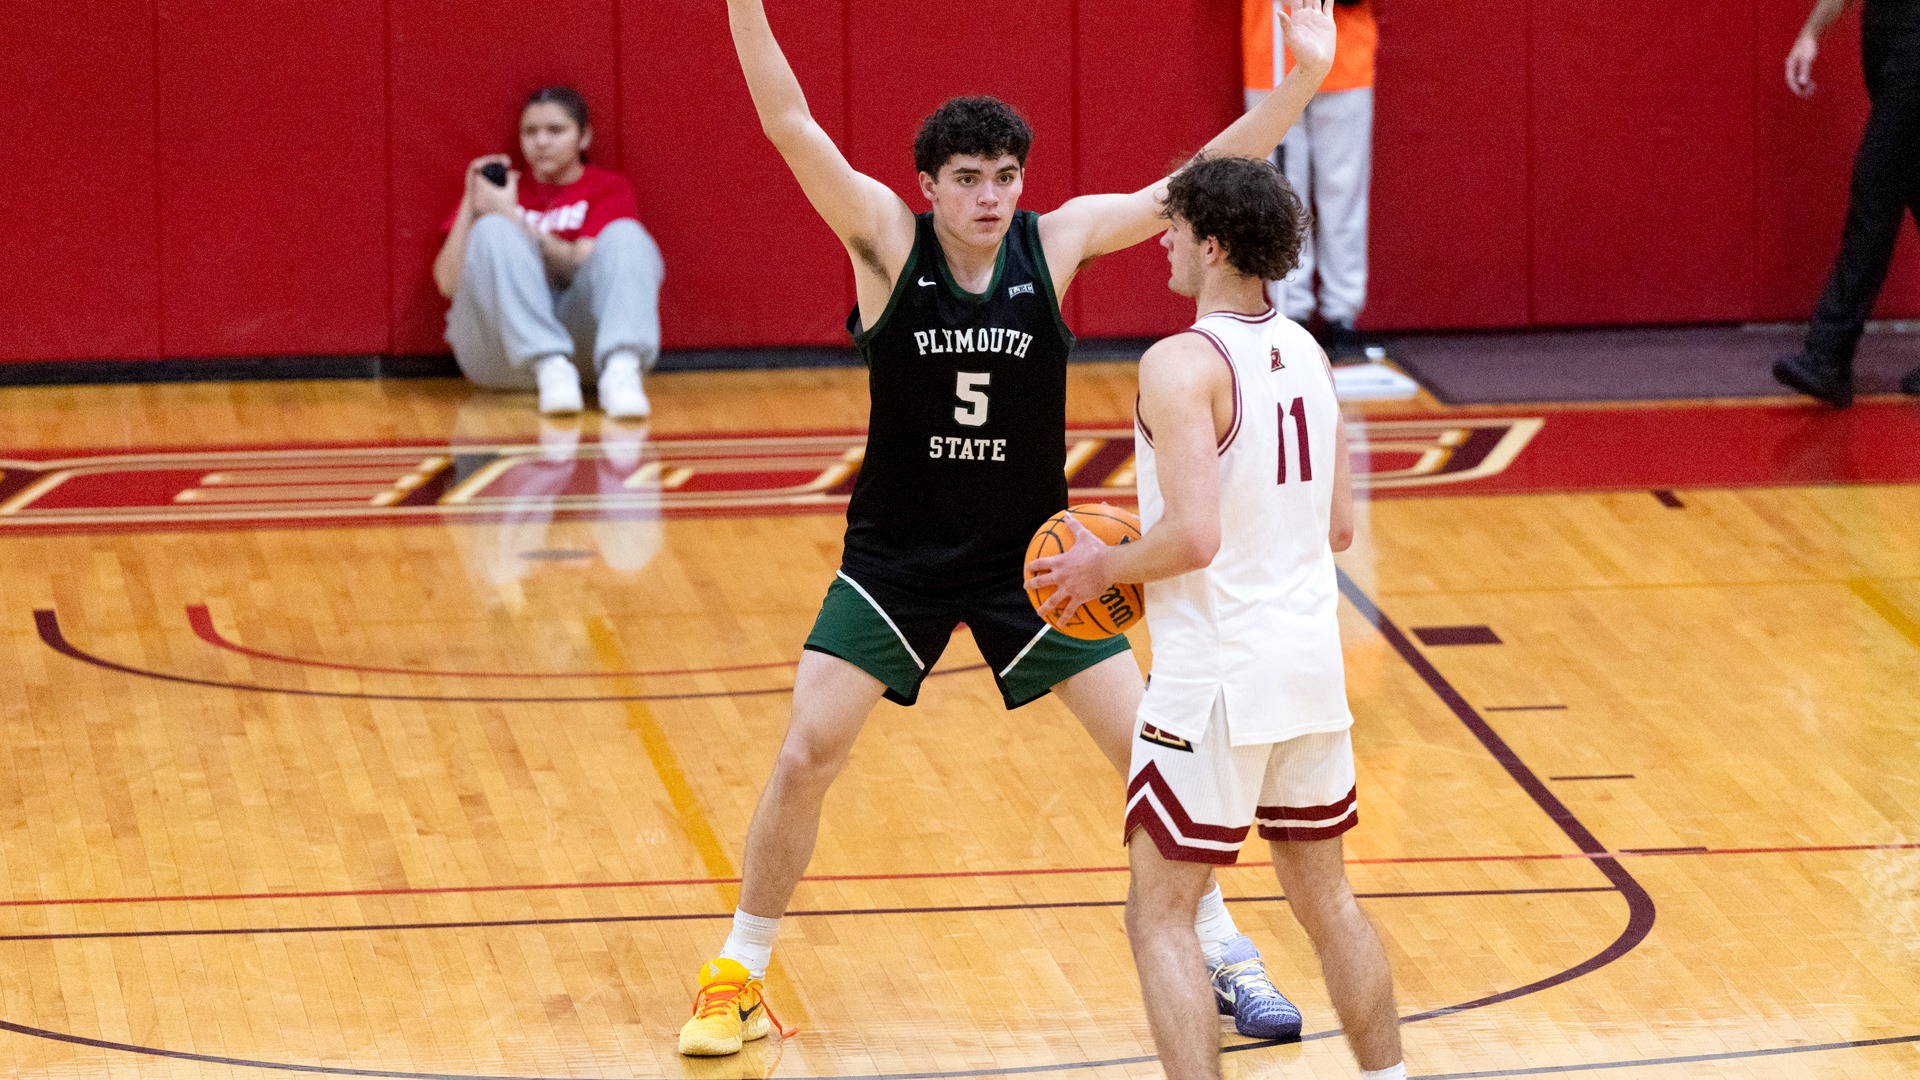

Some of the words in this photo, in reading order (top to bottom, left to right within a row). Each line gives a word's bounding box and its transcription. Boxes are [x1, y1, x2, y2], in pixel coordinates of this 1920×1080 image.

[914, 328, 1033, 358] PLYMOUTH
[954, 371, 990, 427] 5
[930, 436, 1006, 461] STATE
[1277, 397, 1312, 485] 11
[1099, 583, 1134, 628] Wil
